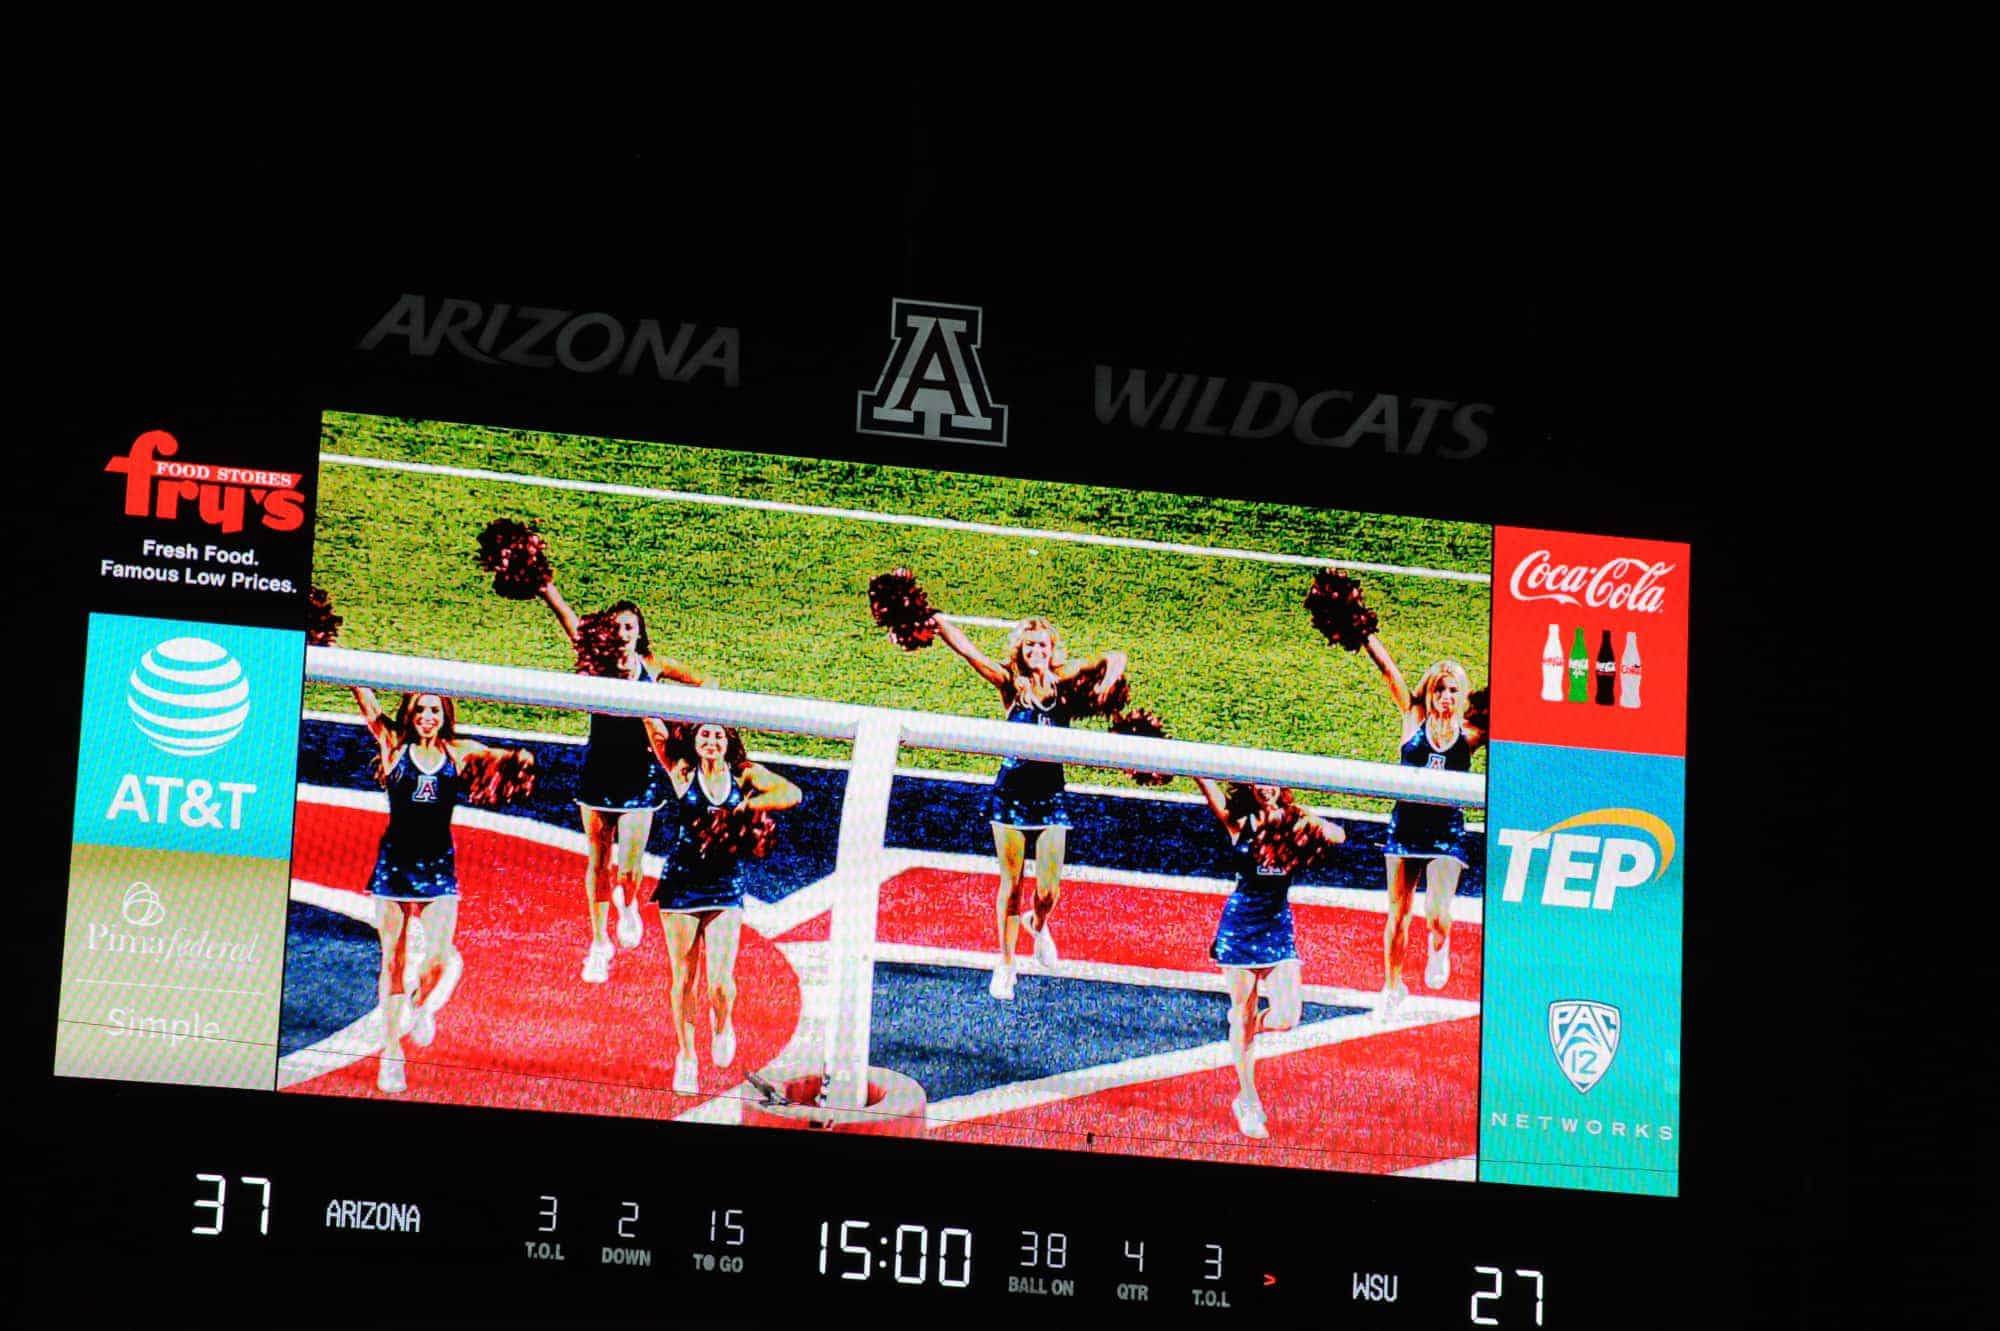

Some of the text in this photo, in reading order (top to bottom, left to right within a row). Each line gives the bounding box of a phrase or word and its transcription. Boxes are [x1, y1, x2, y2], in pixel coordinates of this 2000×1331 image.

[359, 293, 740, 388] ARIZONA
[856, 298, 1008, 447] A
[1093, 364, 1495, 460] WILDCATS
[156, 461, 292, 487] FOOD STORES
[143, 539, 259, 566] Fresh Food.
[101, 560, 297, 594] Famous Low Prices.
[105, 774, 257, 831] AT&T
[1498, 828, 1656, 911] TEP
[107, 1008, 220, 1046] Simple
[1553, 1005, 1618, 1050] PAC
[1571, 1050, 1598, 1076] 12
[1490, 1112, 1674, 1141] NETWORKS
[192, 1173, 271, 1236] 37
[326, 1199, 421, 1233] ARIZONA
[537, 1195, 557, 1232] 3
[618, 1202, 639, 1238] 2
[709, 1209, 744, 1246] 15
[601, 1247, 651, 1267] DOWN
[692, 1253, 744, 1273] TO GO
[818, 1220, 973, 1288] 15:00
[1019, 1231, 1067, 1269] 38
[1123, 1240, 1144, 1272] 4
[1203, 1244, 1222, 1280] 3
[1008, 1276, 1074, 1297] BALL ON
[1117, 1283, 1149, 1301] QTR
[1352, 1272, 1399, 1302] WSU
[1471, 1265, 1543, 1327] 27
